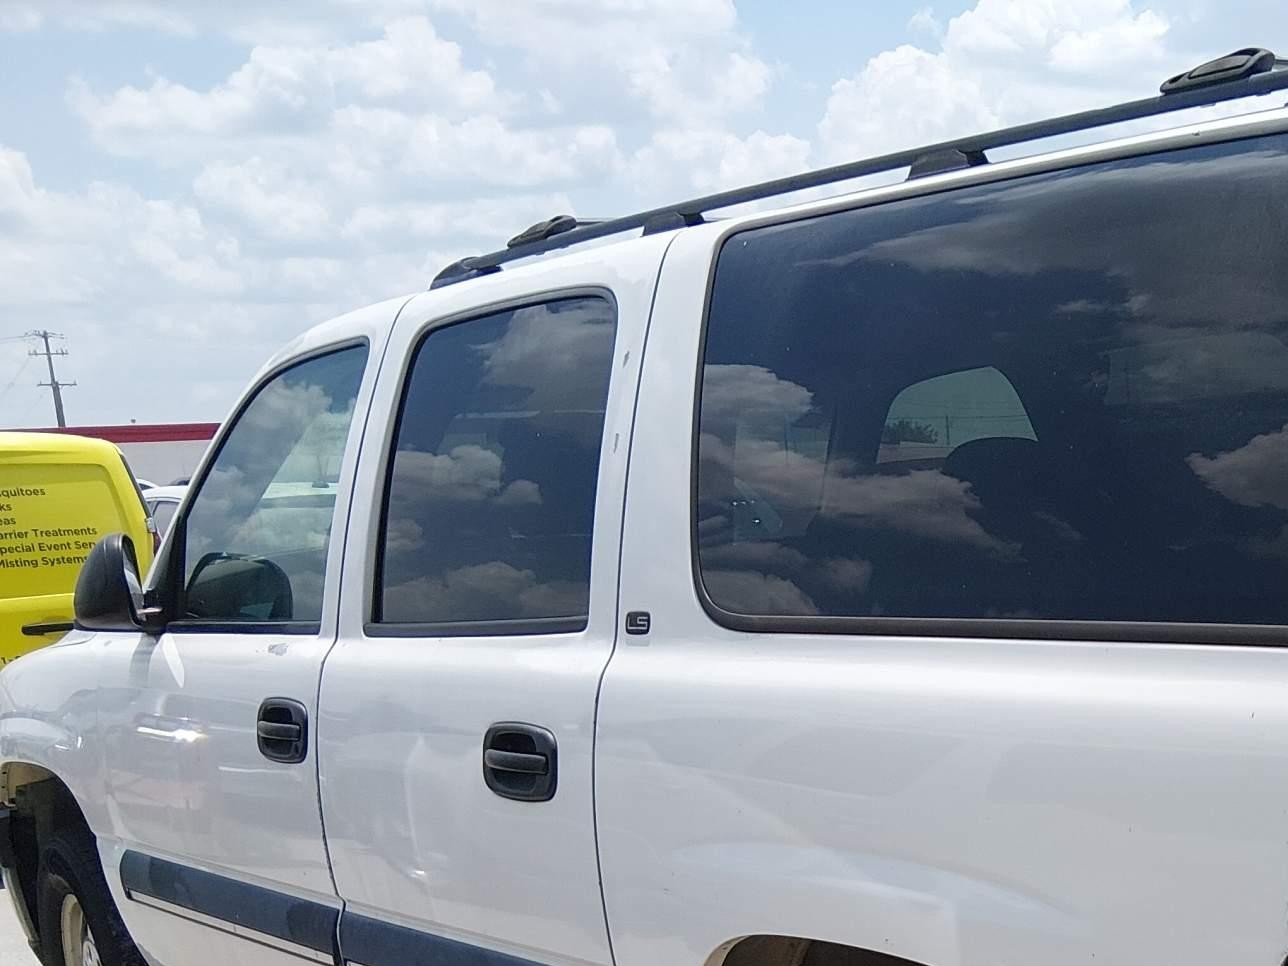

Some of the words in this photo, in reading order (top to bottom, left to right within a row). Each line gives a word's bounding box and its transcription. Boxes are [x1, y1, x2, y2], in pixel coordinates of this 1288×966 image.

[0, 487, 46, 498] quitoes
[31, 527, 98, 537] Treatments
[38, 542, 72, 551] Event
[74, 540, 96, 549] Ser
[627, 616, 648, 630] LS
